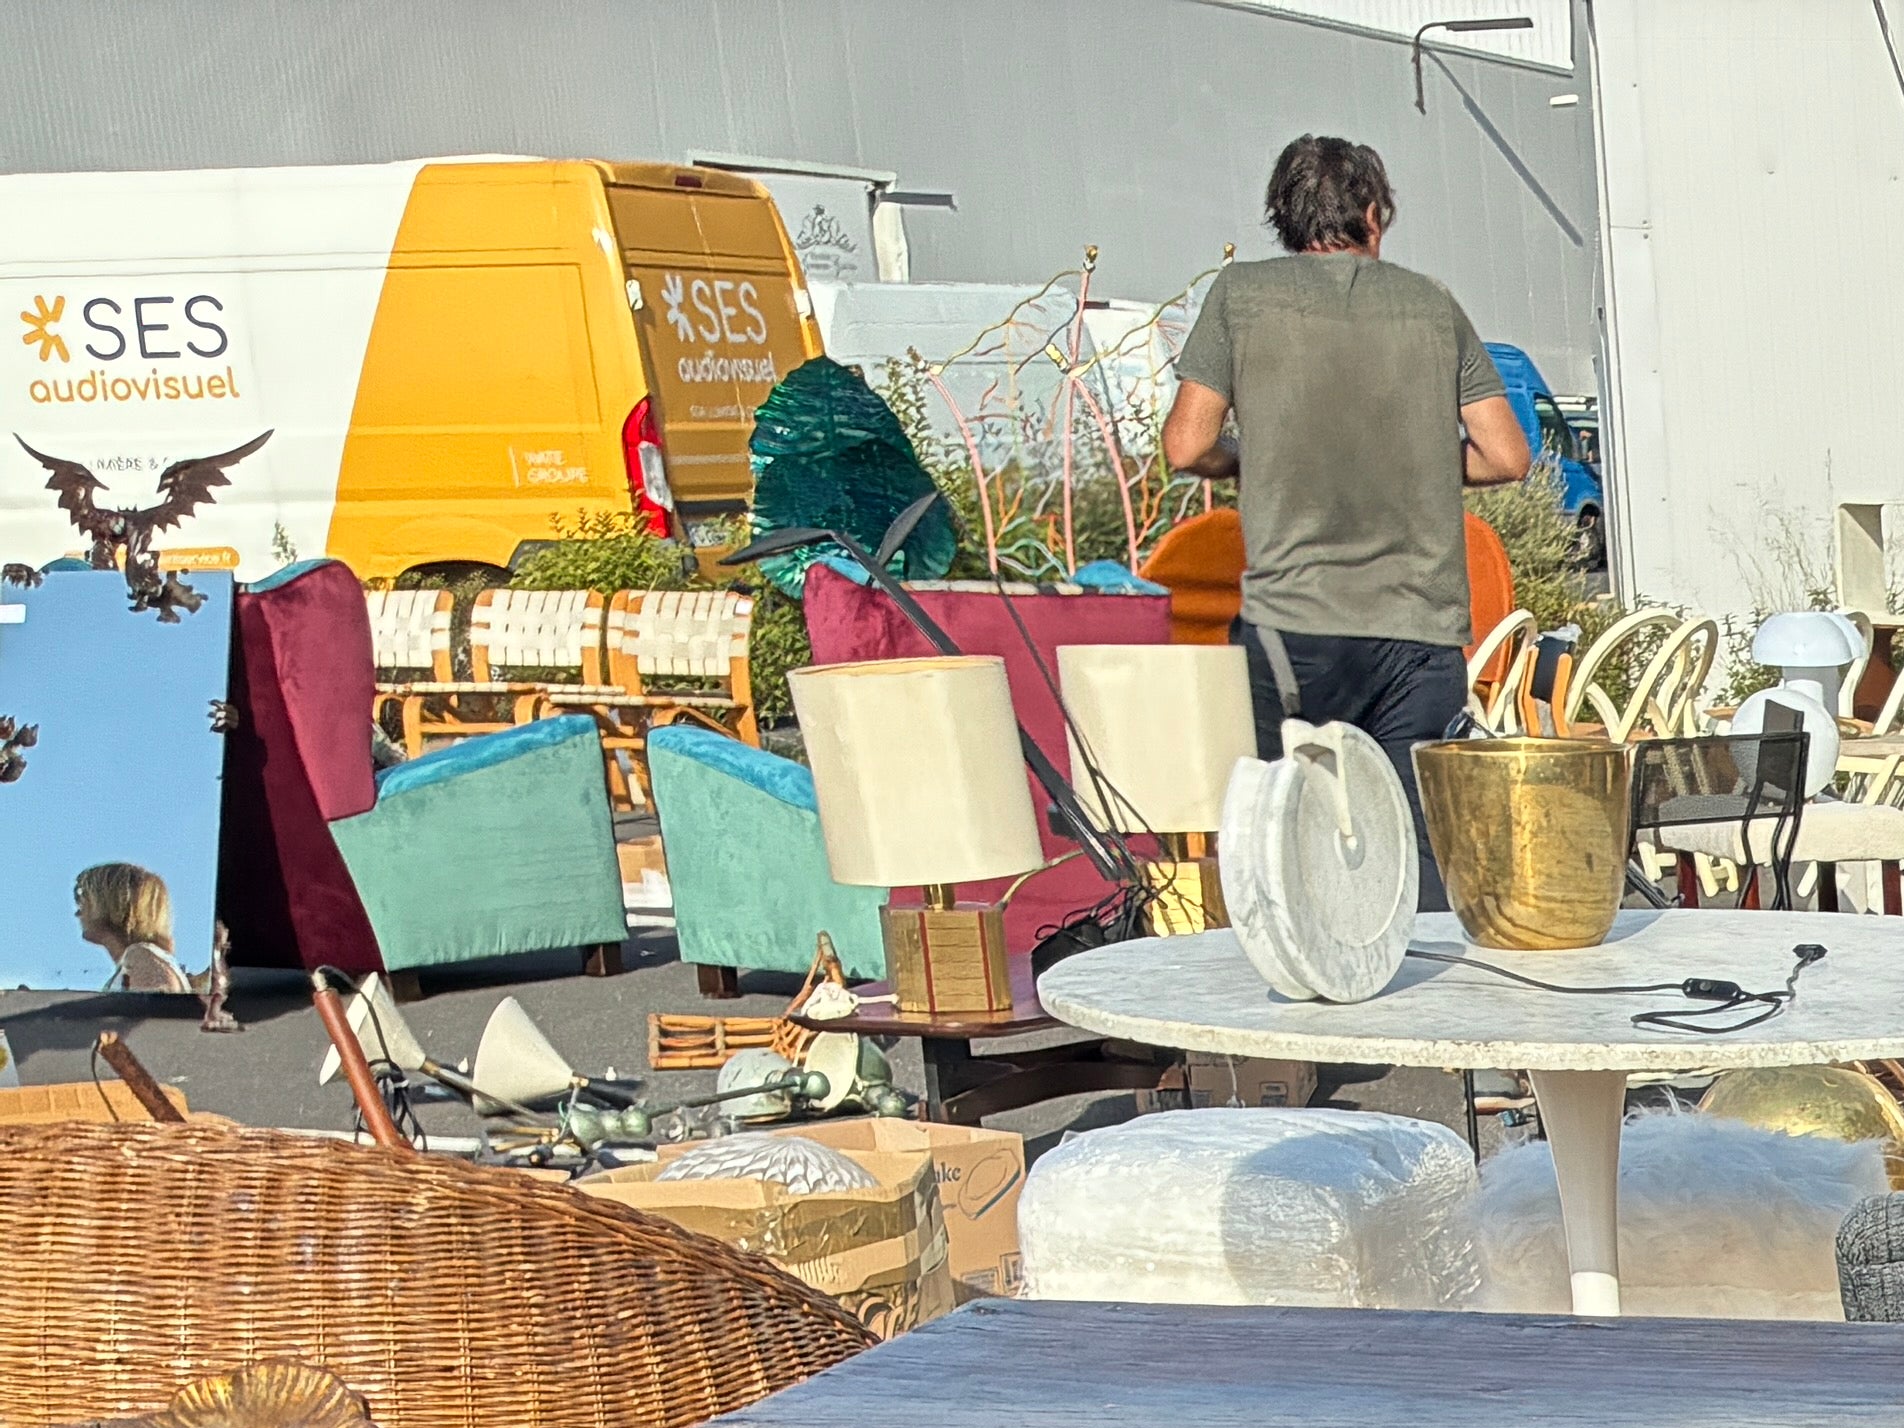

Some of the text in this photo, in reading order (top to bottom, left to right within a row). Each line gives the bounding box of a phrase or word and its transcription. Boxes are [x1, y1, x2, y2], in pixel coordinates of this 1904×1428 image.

[83, 294, 228, 361] SES
[691, 279, 767, 345] SES
[29, 366, 240, 403] audiovisuel
